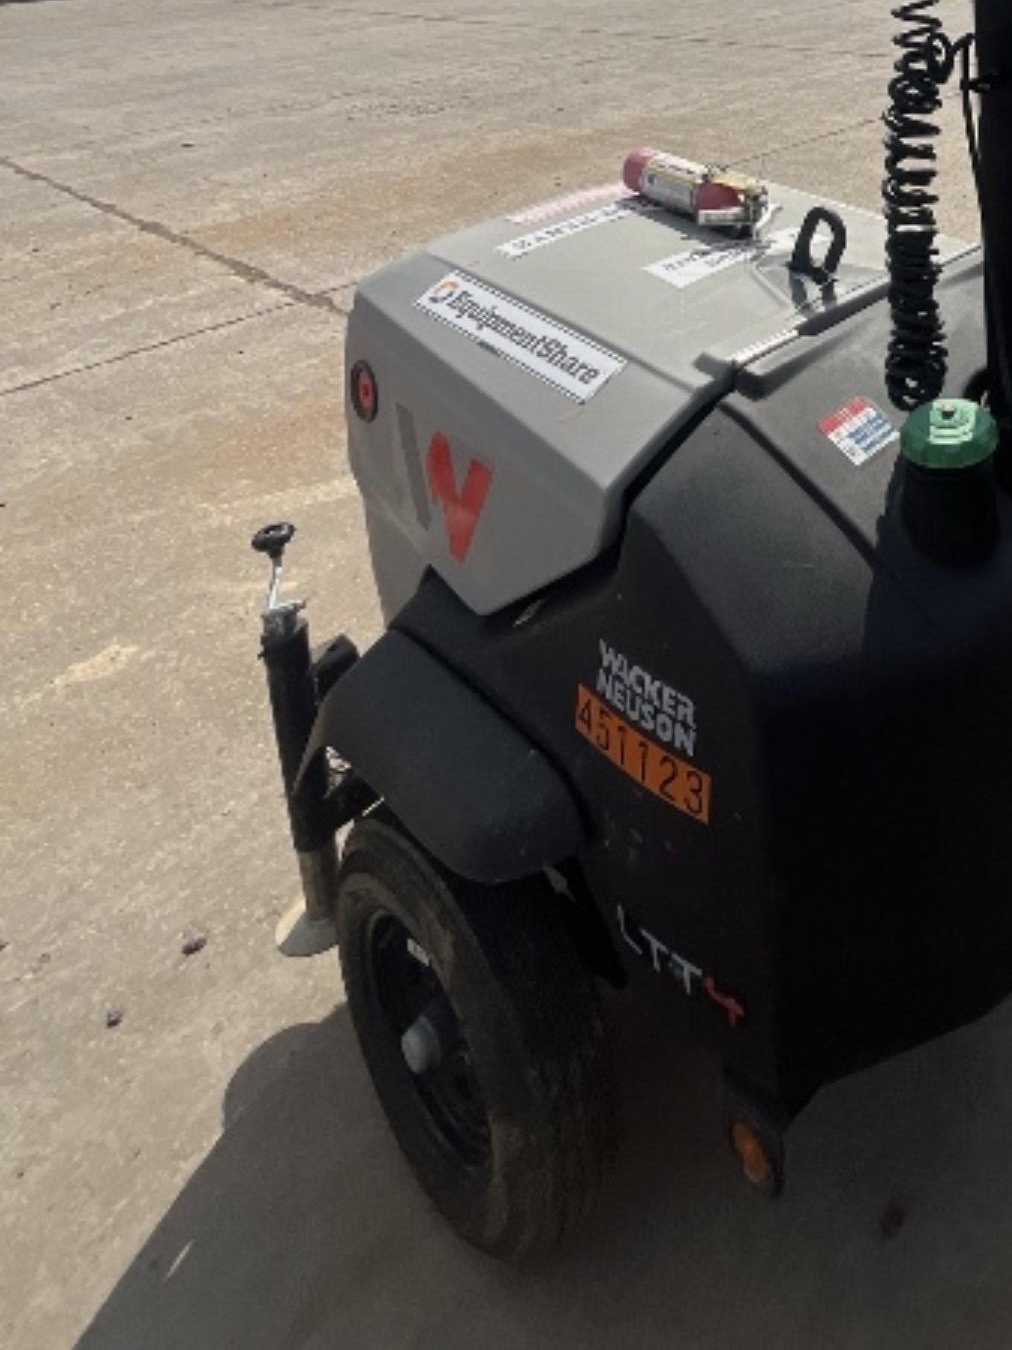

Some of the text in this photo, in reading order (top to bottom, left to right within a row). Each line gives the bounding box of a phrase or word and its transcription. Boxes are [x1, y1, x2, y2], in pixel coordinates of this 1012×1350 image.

[446, 290, 601, 386] EquipmentShare
[596, 667, 697, 757] NEUSON
[599, 638, 696, 728] WACKER
[577, 697, 704, 815] 451123
